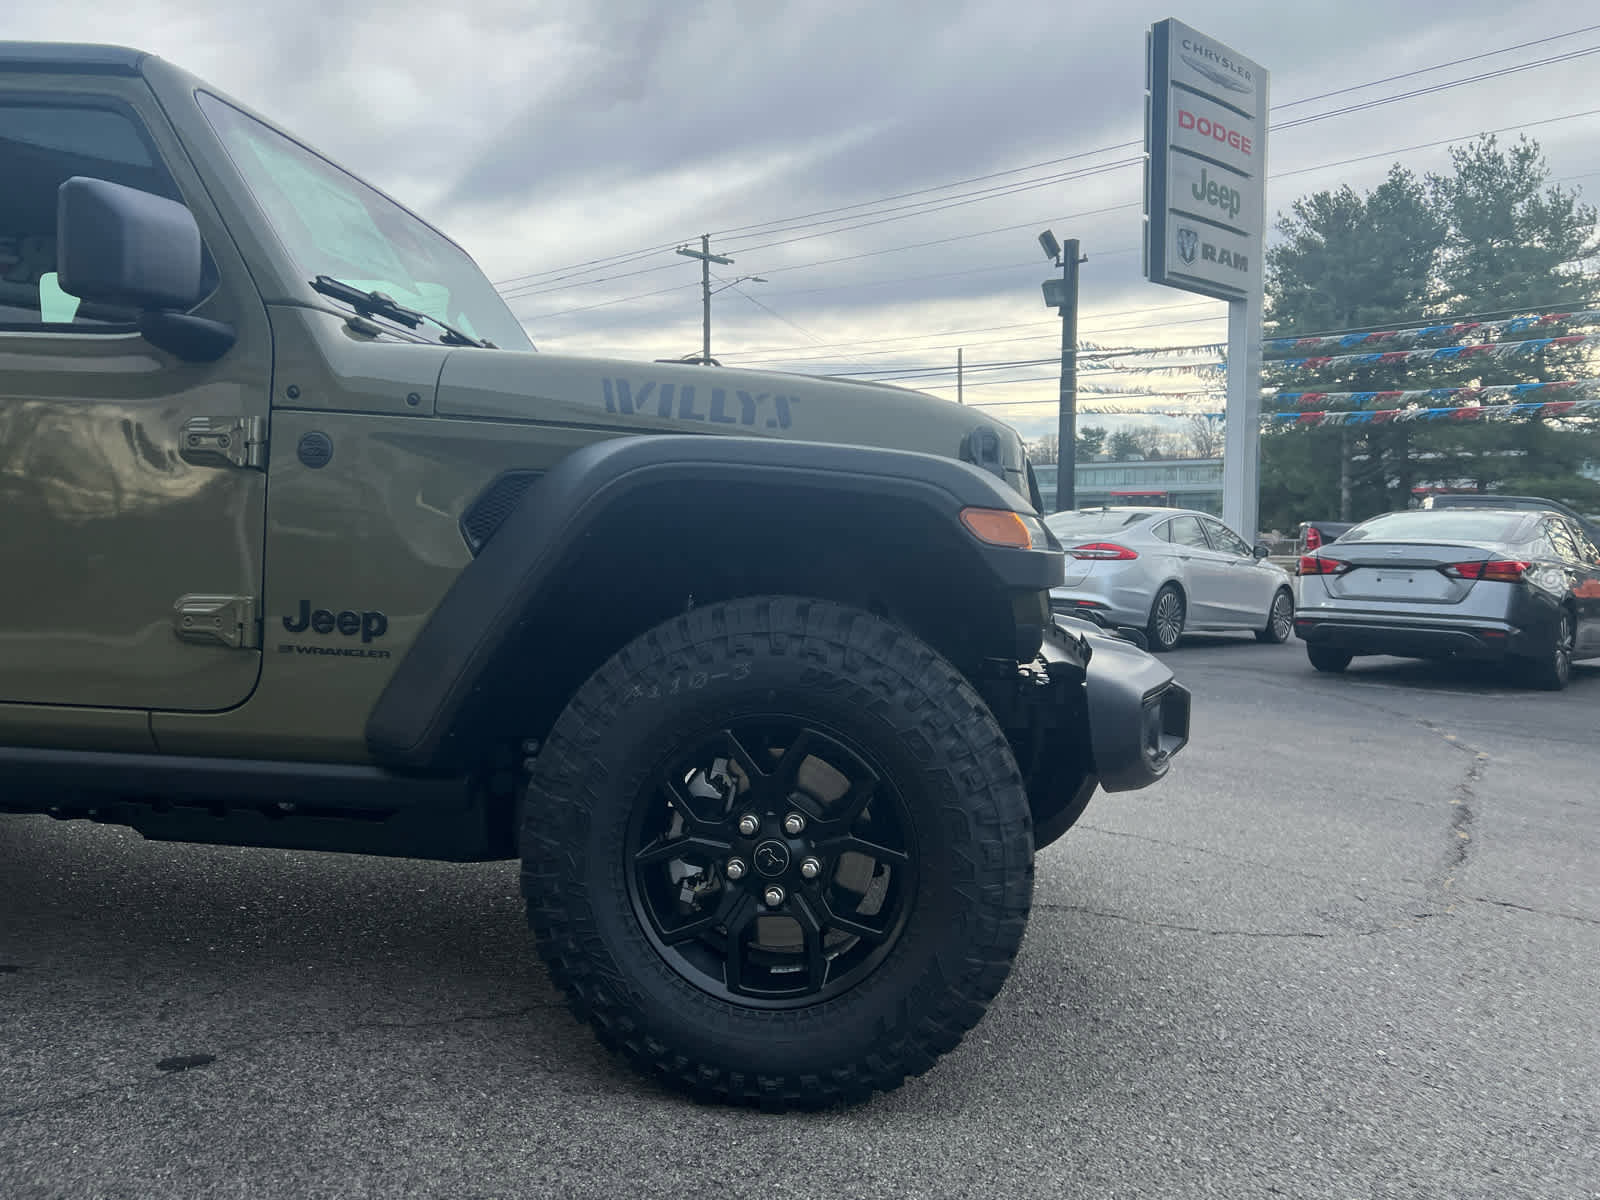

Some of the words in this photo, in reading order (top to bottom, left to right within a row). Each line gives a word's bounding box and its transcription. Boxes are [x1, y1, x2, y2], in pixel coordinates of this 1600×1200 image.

[1182, 39, 1252, 81] CHRYSLER
[1178, 110, 1252, 154] DODGE
[1192, 168, 1240, 219] Jeep
[1201, 243, 1248, 272] RAM
[602, 377, 800, 429] WILLYS
[282, 600, 388, 643] Jeep
[295, 645, 391, 659] WRANGLER
